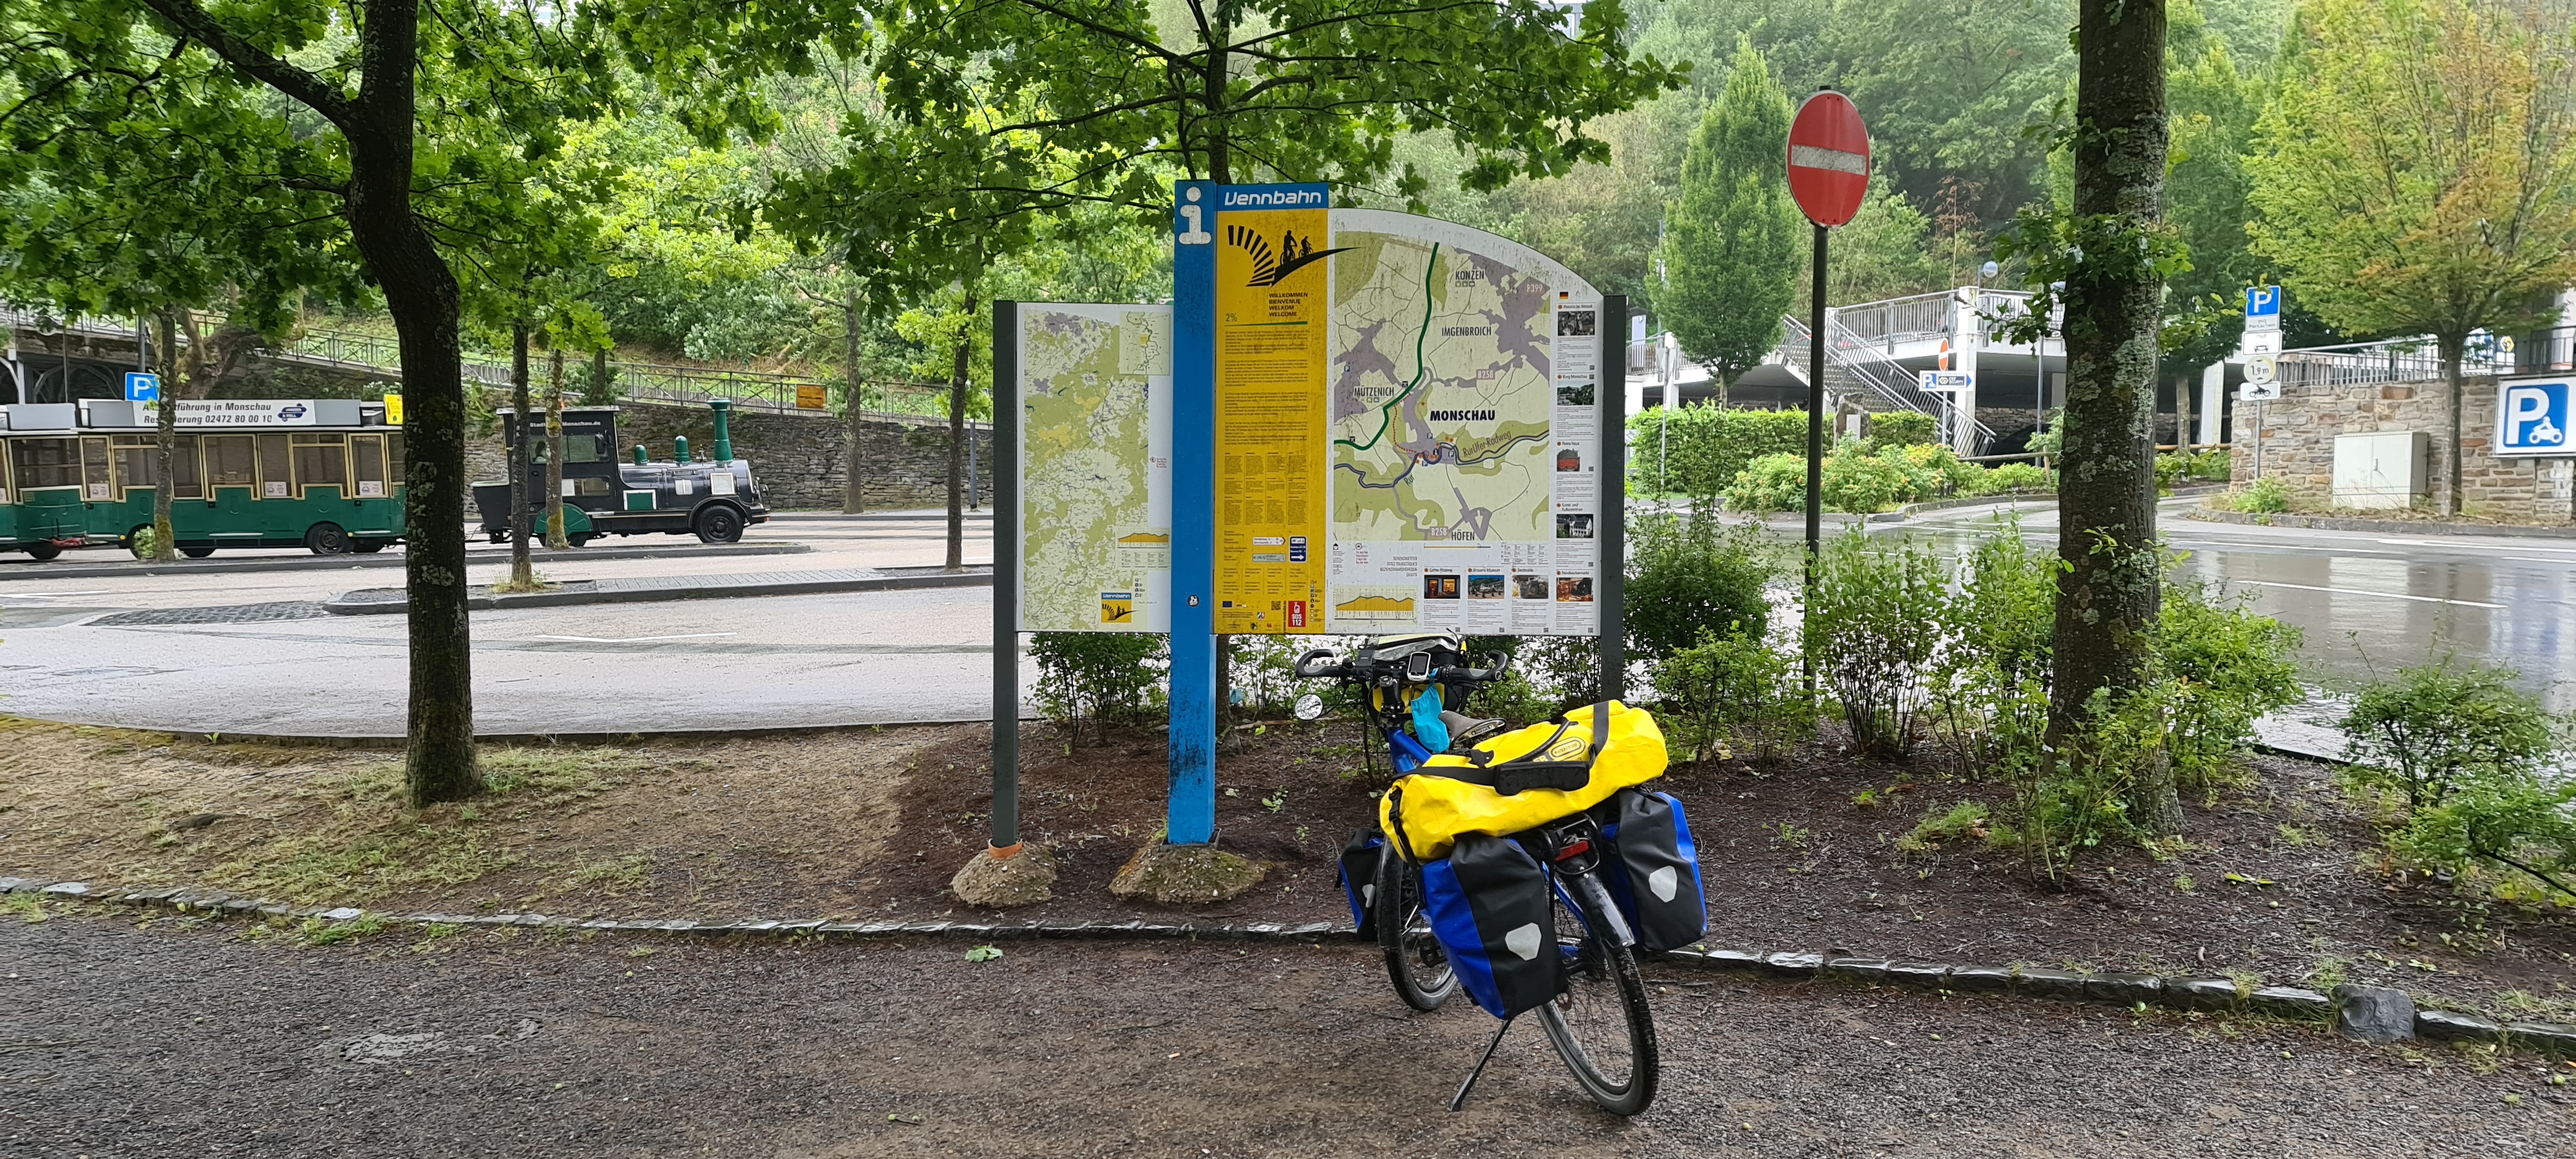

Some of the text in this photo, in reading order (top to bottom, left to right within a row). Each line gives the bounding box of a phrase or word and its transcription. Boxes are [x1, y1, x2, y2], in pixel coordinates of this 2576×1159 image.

[1224, 190, 1321, 206] Vennbahn
[1455, 270, 1484, 280] KONZEN
[2254, 290, 2272, 313] P
[1226, 312, 1238, 322] 2%
[1441, 326, 1492, 336] IMGENBROICH
[1477, 370, 1493, 379] B258
[133, 377, 153, 397] P
[1922, 374, 1933, 388] P
[1354, 385, 1394, 397] MÜTZENICH
[214, 402, 222, 411] in
[225, 402, 271, 411] Monschau
[205, 415, 232, 423] 02472
[235, 415, 245, 423] 80
[249, 415, 259, 423] 00
[263, 415, 272, 423] 10
[1430, 410, 1495, 422] MONSCHAU
[2506, 388, 2550, 444] P
[1463, 431, 1511, 457] RurUfer-Radweg
[1403, 474, 1415, 486] Rur
[1431, 527, 1447, 536] B258
[1452, 529, 1475, 541] HÖFEN
